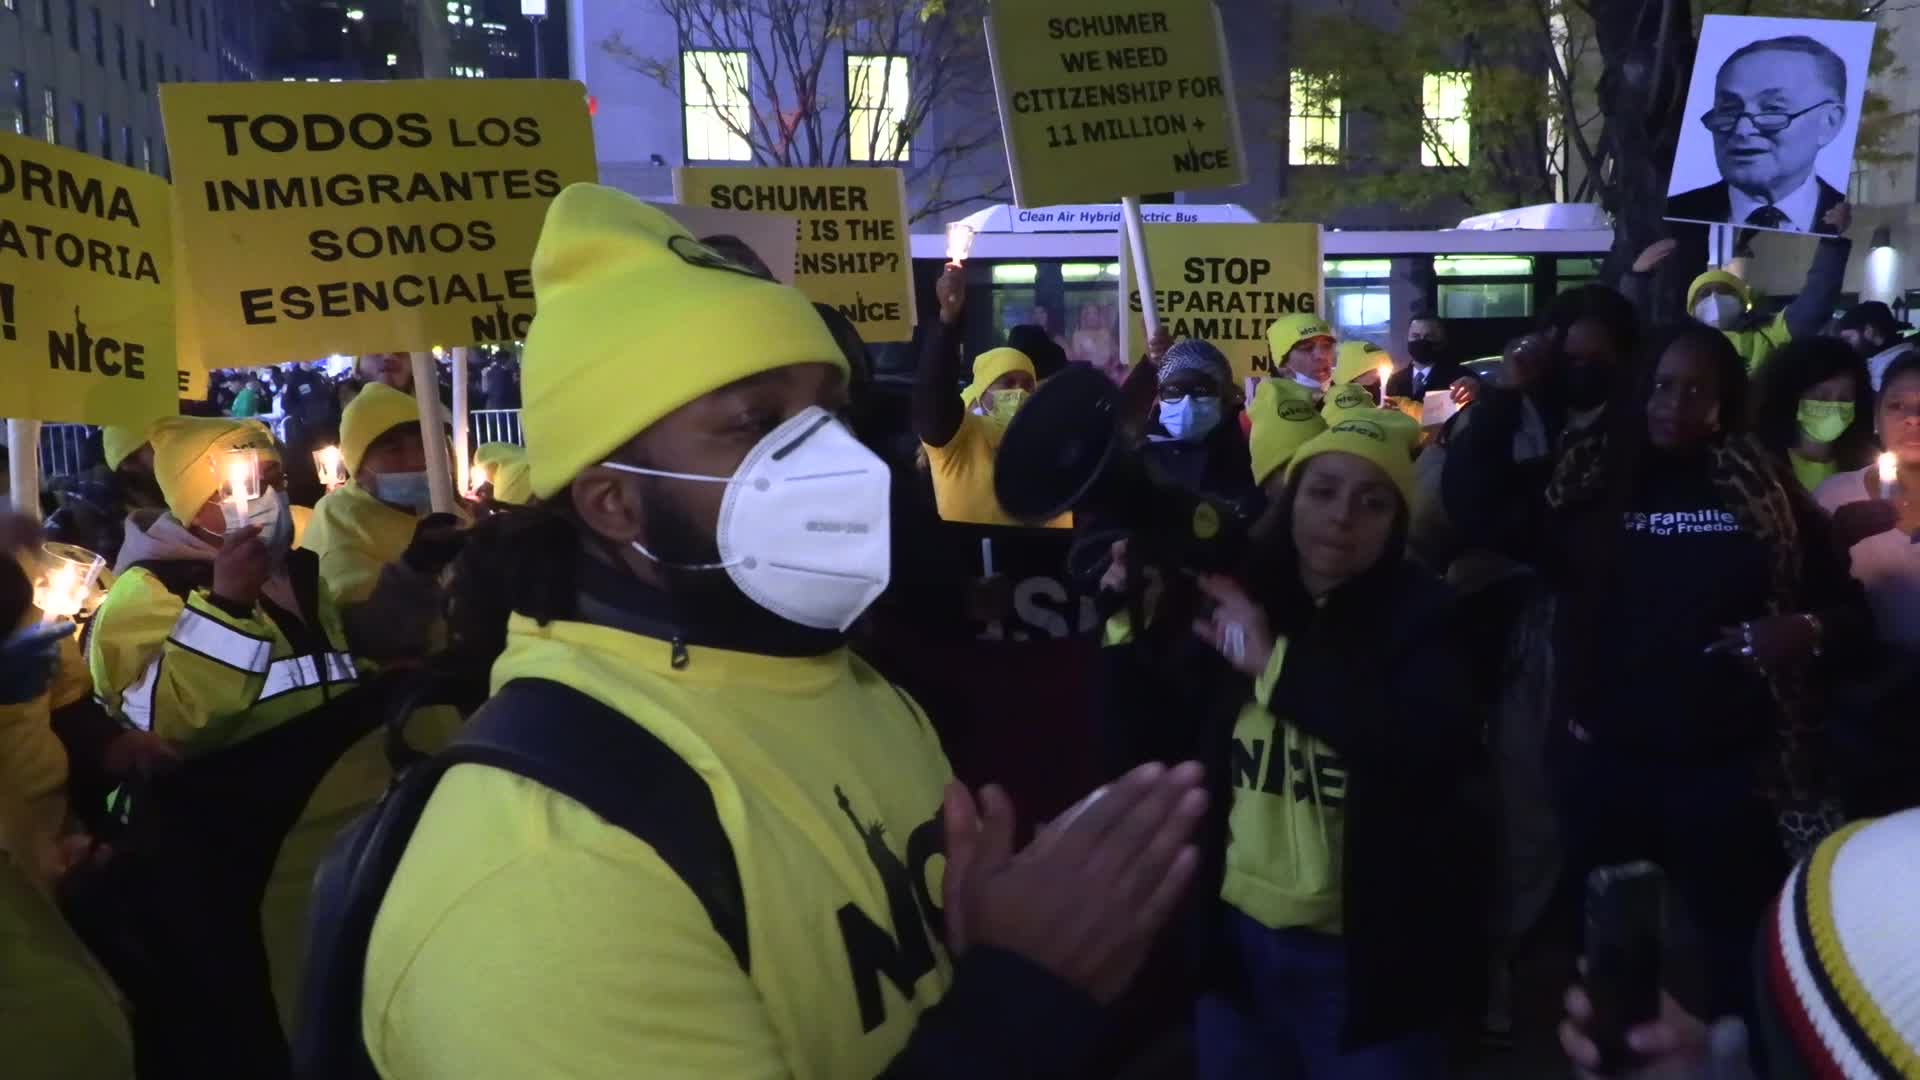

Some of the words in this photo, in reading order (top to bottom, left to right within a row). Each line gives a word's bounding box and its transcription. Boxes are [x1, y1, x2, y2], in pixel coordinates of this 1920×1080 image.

[1048, 12, 1168, 39] SCHUMER
[1060, 51, 1101, 72] WE
[1106, 47, 1167, 70] NEED
[1013, 80, 1172, 113] CITIZENSHIP
[1177, 76, 1223, 98] FOR
[207, 112, 432, 156] TODOS
[449, 116, 541, 148] LOS
[1047, 124, 1077, 147] 11
[1083, 114, 1186, 142] MILLION
[1174, 138, 1228, 172] NICE
[205, 169, 561, 212] INMIGRANTES
[711, 184, 868, 211] SCHUMER
[810, 220, 838, 241] IS
[846, 219, 895, 241] THE
[1019, 211, 1054, 223] Clean
[1057, 211, 1076, 223] Air
[1080, 211, 1121, 224] Hybrid
[1175, 212, 1198, 223] Bus
[308, 220, 496, 262] SOMOS
[795, 252, 899, 275] NSHIP?
[1184, 257, 1270, 284] STOP
[48, 304, 145, 380] NICE
